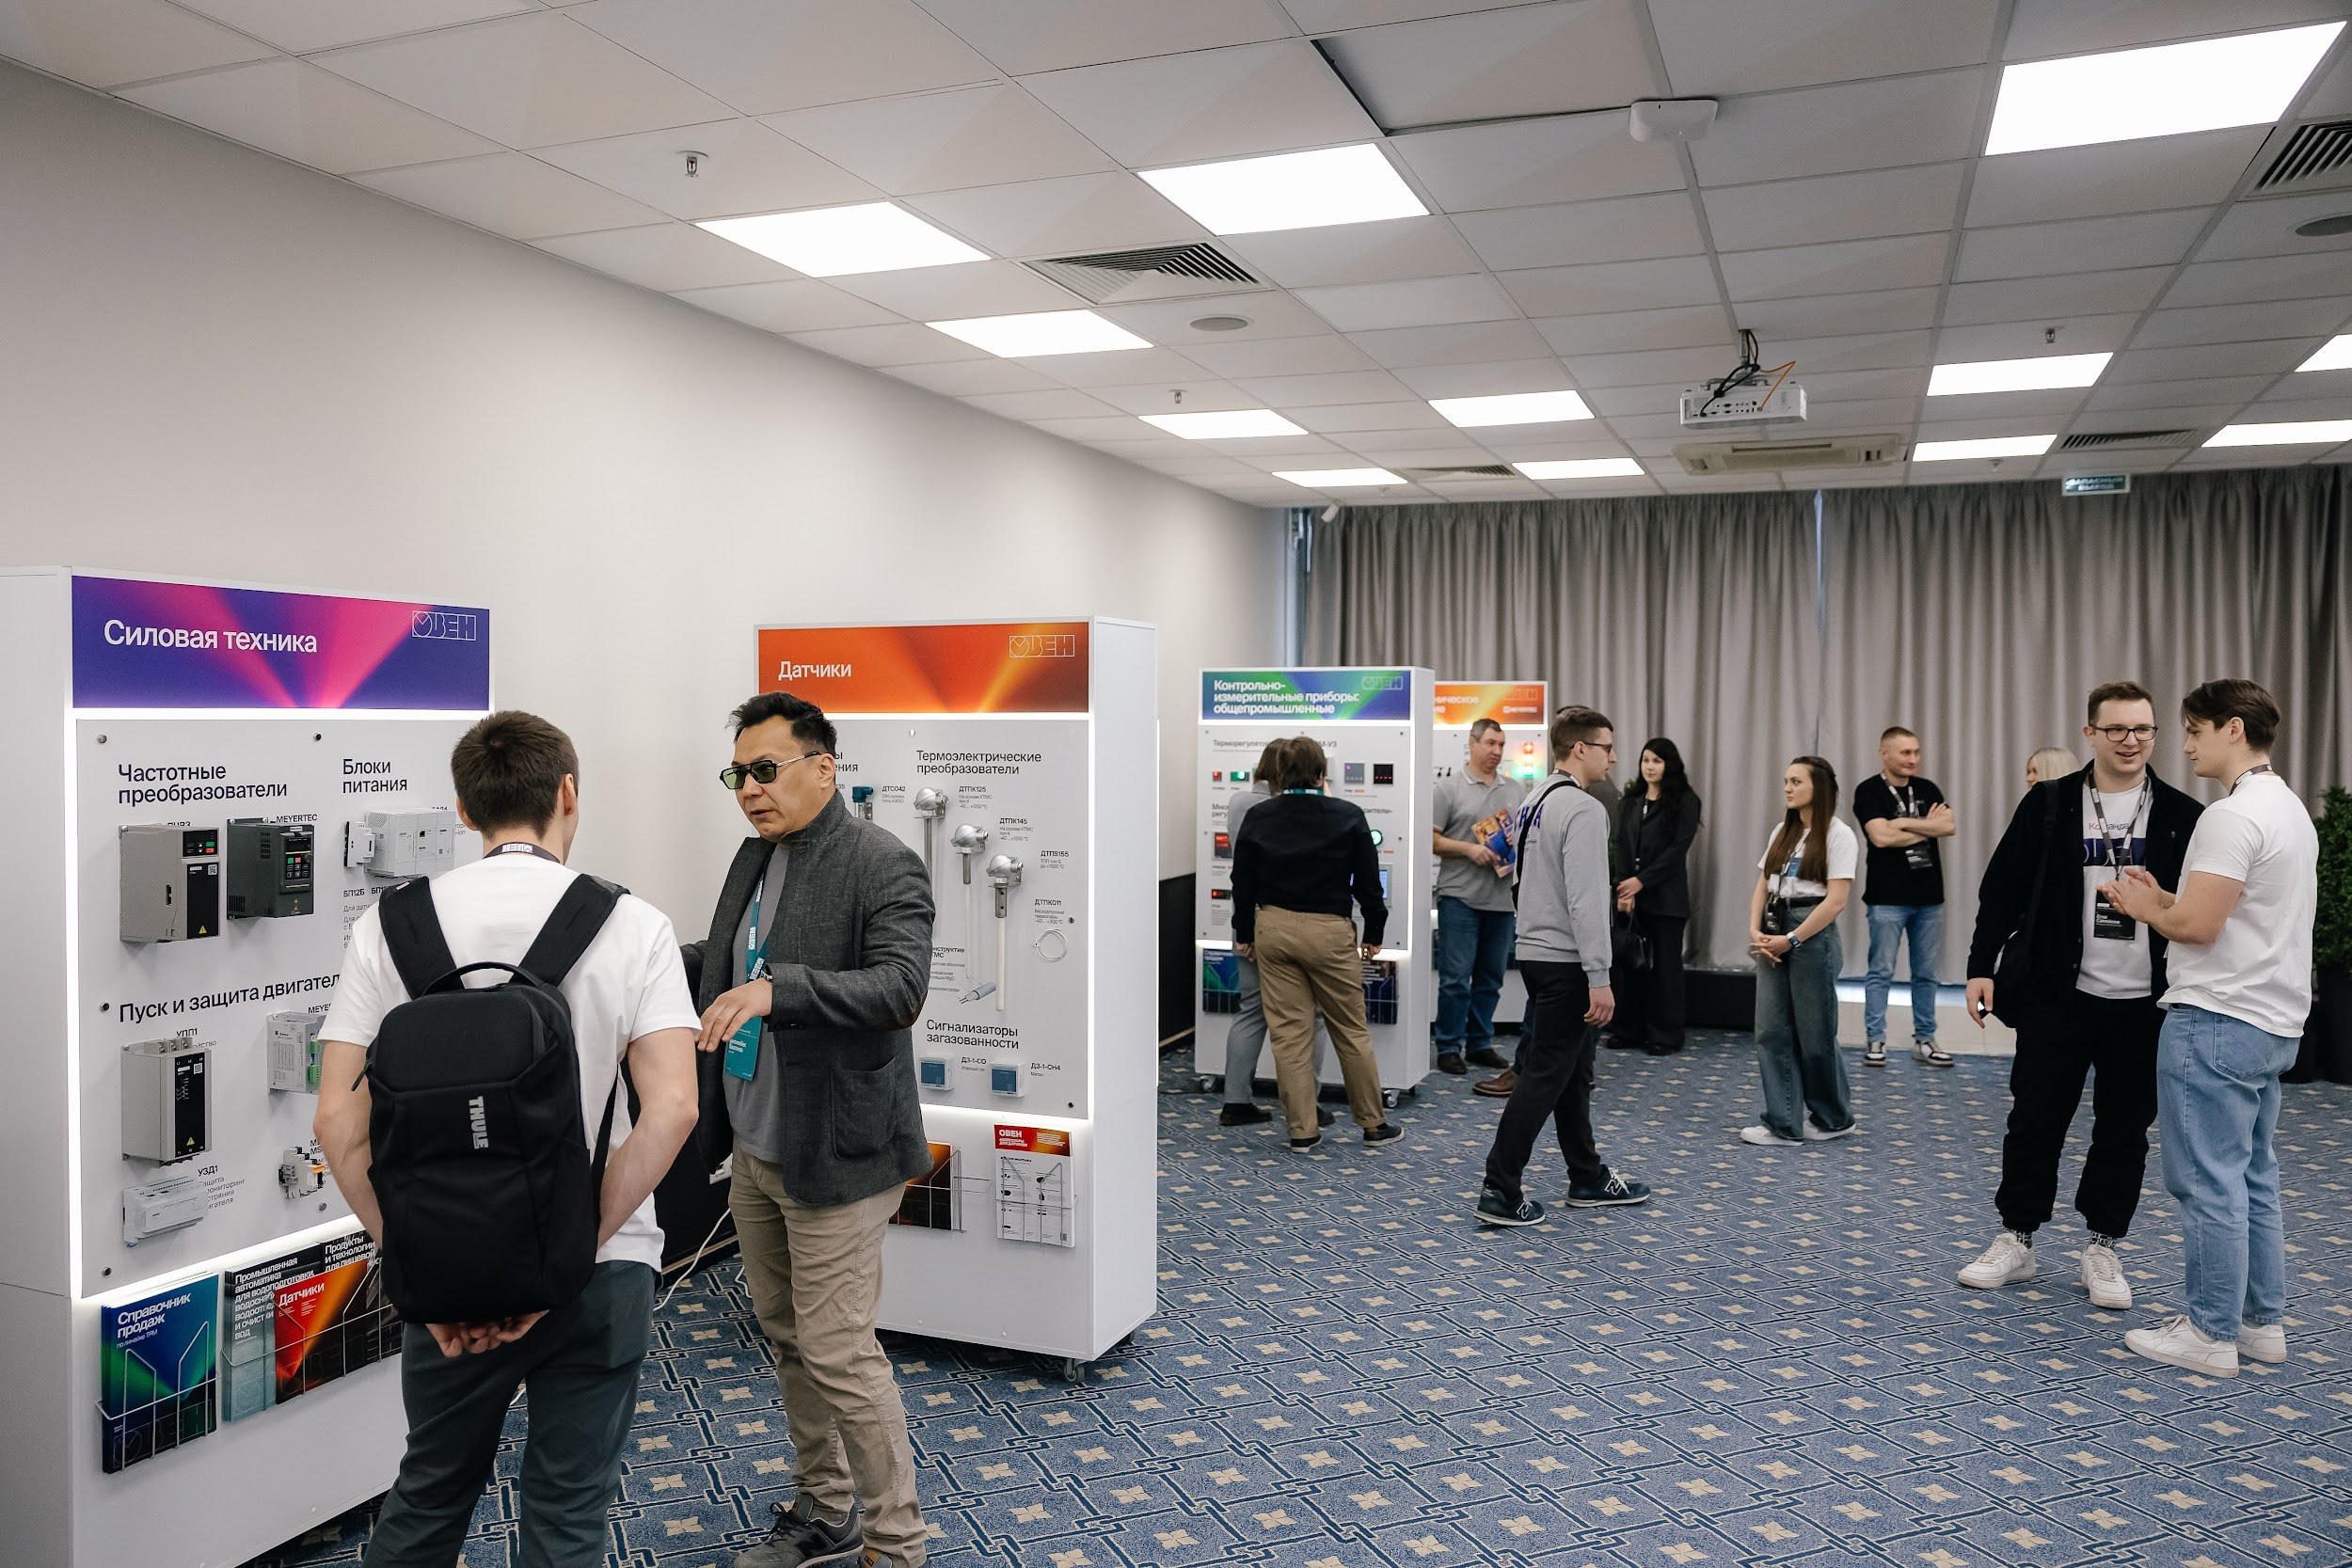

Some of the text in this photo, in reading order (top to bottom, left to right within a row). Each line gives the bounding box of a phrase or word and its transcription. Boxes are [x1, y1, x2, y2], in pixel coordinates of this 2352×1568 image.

[412, 610, 476, 641] ОВЕН
[103, 619, 317, 655] Силовая техника
[1009, 634, 1075, 658] ОВЕН
[778, 660, 851, 681] Датчики
[1213, 679, 1286, 691] Контрольно-
[1213, 692, 1304, 704] измерительные
[1213, 703, 1336, 716] общепромышленные
[343, 758, 390, 775] Блоки
[916, 750, 1041, 764] Термоэлектрические
[119, 764, 226, 783] Частотные
[916, 763, 1020, 776] преобразователи
[119, 783, 287, 807] преобразователи
[342, 779, 407, 794] питания
[276, 814, 318, 824] MEYERTEC
[2089, 821, 2130, 832] Коанда
[119, 1003, 167, 1024] Пуск
[172, 999, 184, 1014] и
[189, 988, 260, 1010] защита
[926, 1019, 1018, 1037] Сигнализаторы
[926, 1034, 1019, 1049] загазованности
[469, 1096, 489, 1149] THULE
[998, 1129, 1023, 1138] ОВЕН
[198, 1164, 218, 1177] УЗД1
[325, 1235, 364, 1255] Продукты
[325, 1241, 376, 1264] и технологии
[234, 1257, 298, 1285] Промышленная
[234, 1271, 281, 1294] автоматика
[234, 1270, 315, 1306] для водоподготовки,
[278, 1282, 325, 1307] Датчики
[118, 1292, 192, 1325] Справочник
[117, 1313, 166, 1338] продаж
[234, 1322, 241, 1331] и
[234, 1328, 250, 1341] вод
